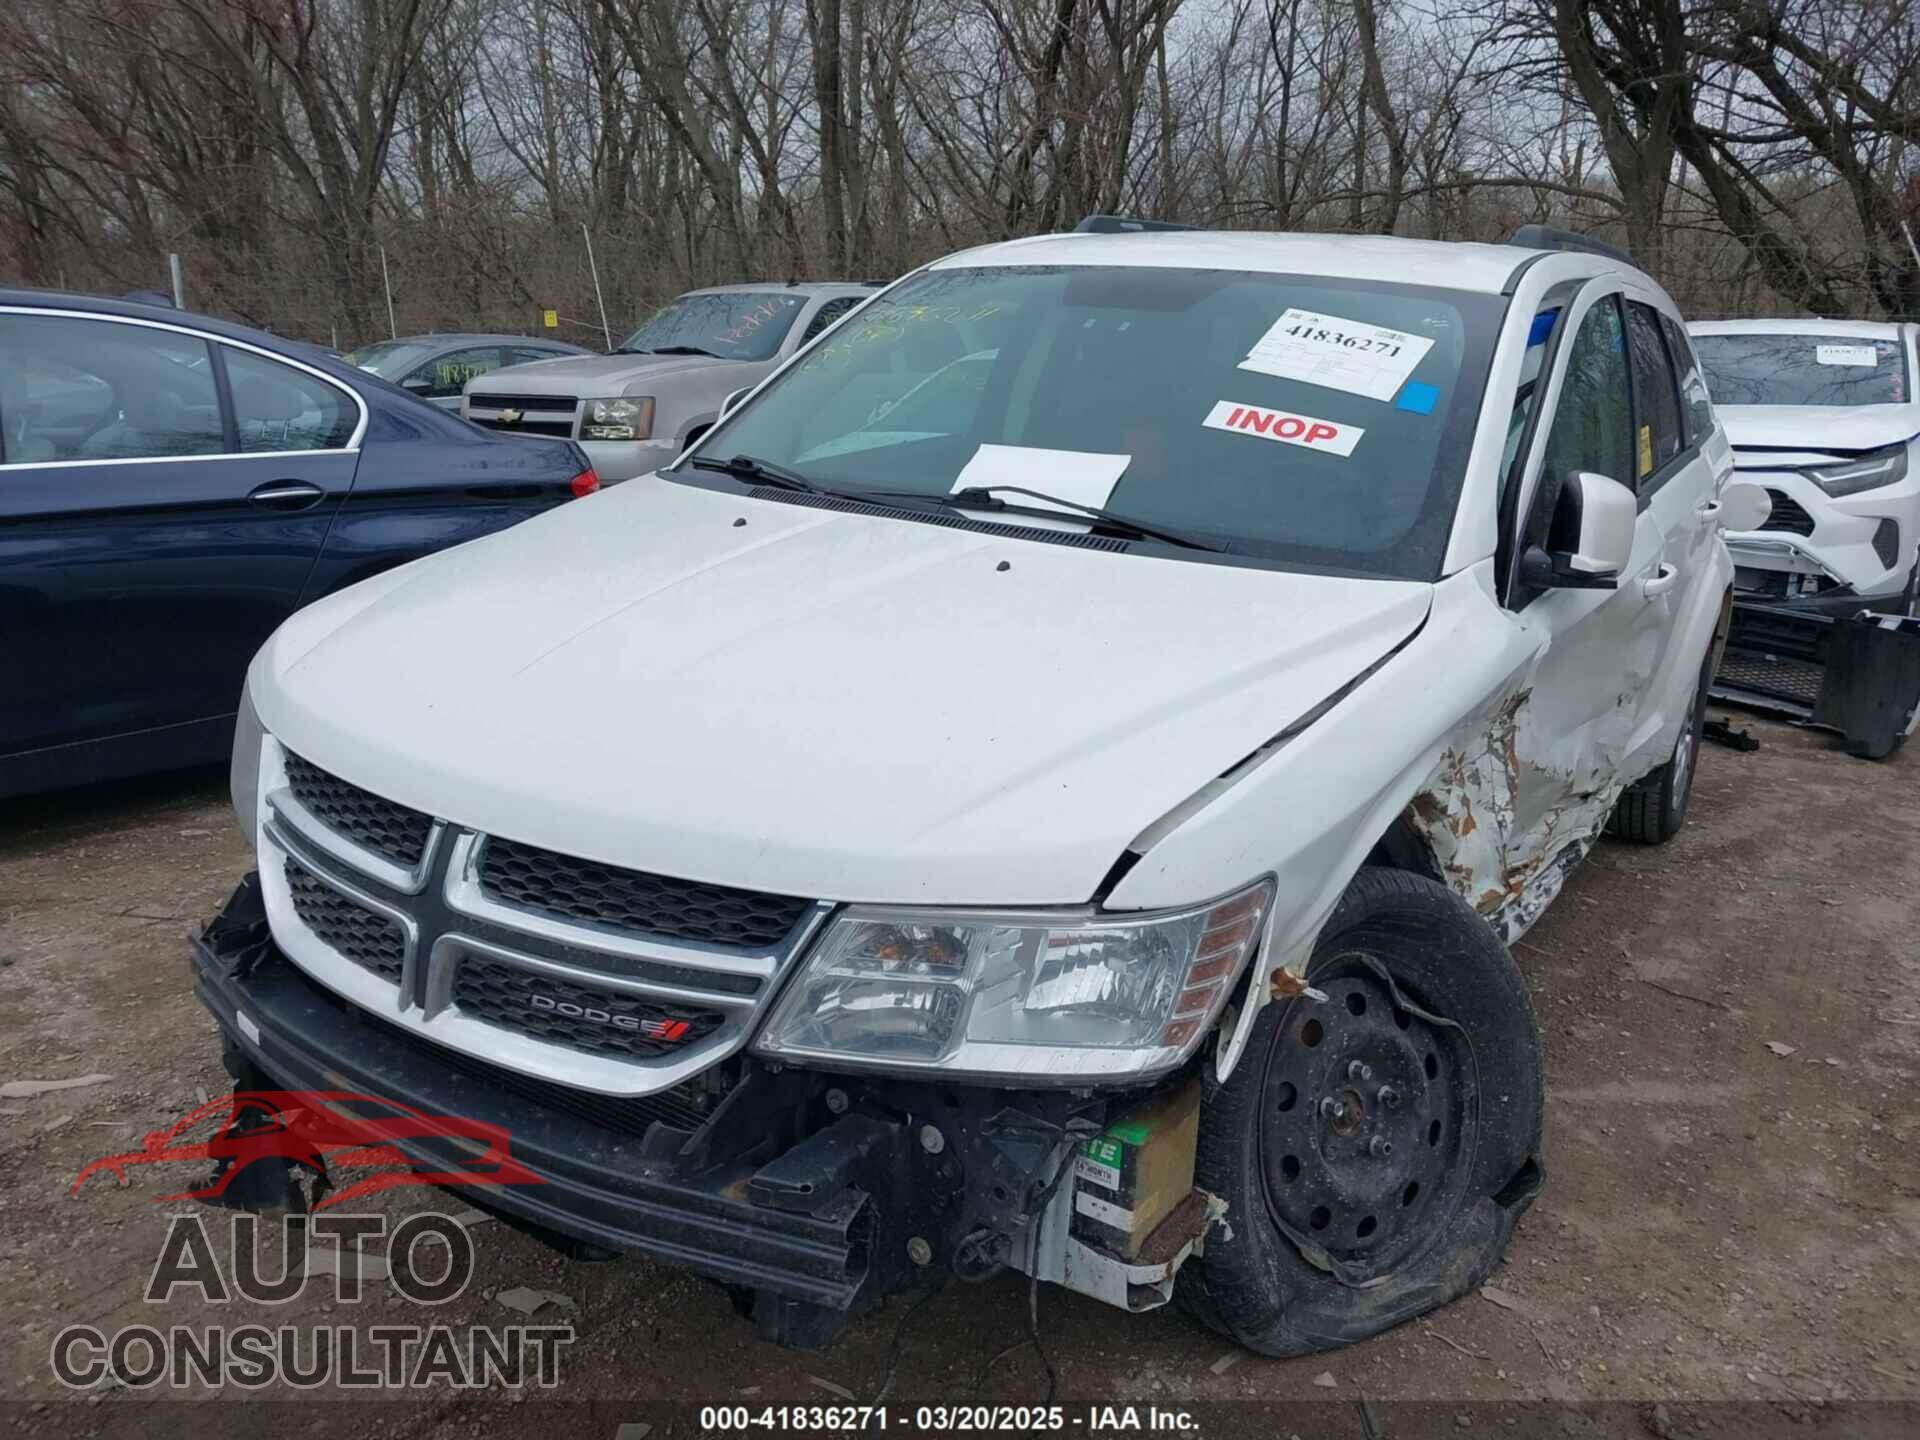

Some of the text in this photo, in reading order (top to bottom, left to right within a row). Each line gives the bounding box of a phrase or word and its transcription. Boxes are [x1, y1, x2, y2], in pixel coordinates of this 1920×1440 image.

[1286, 325, 1401, 357] 41836271
[1227, 408, 1337, 443] INOP
[531, 994, 667, 1034] DODGE
